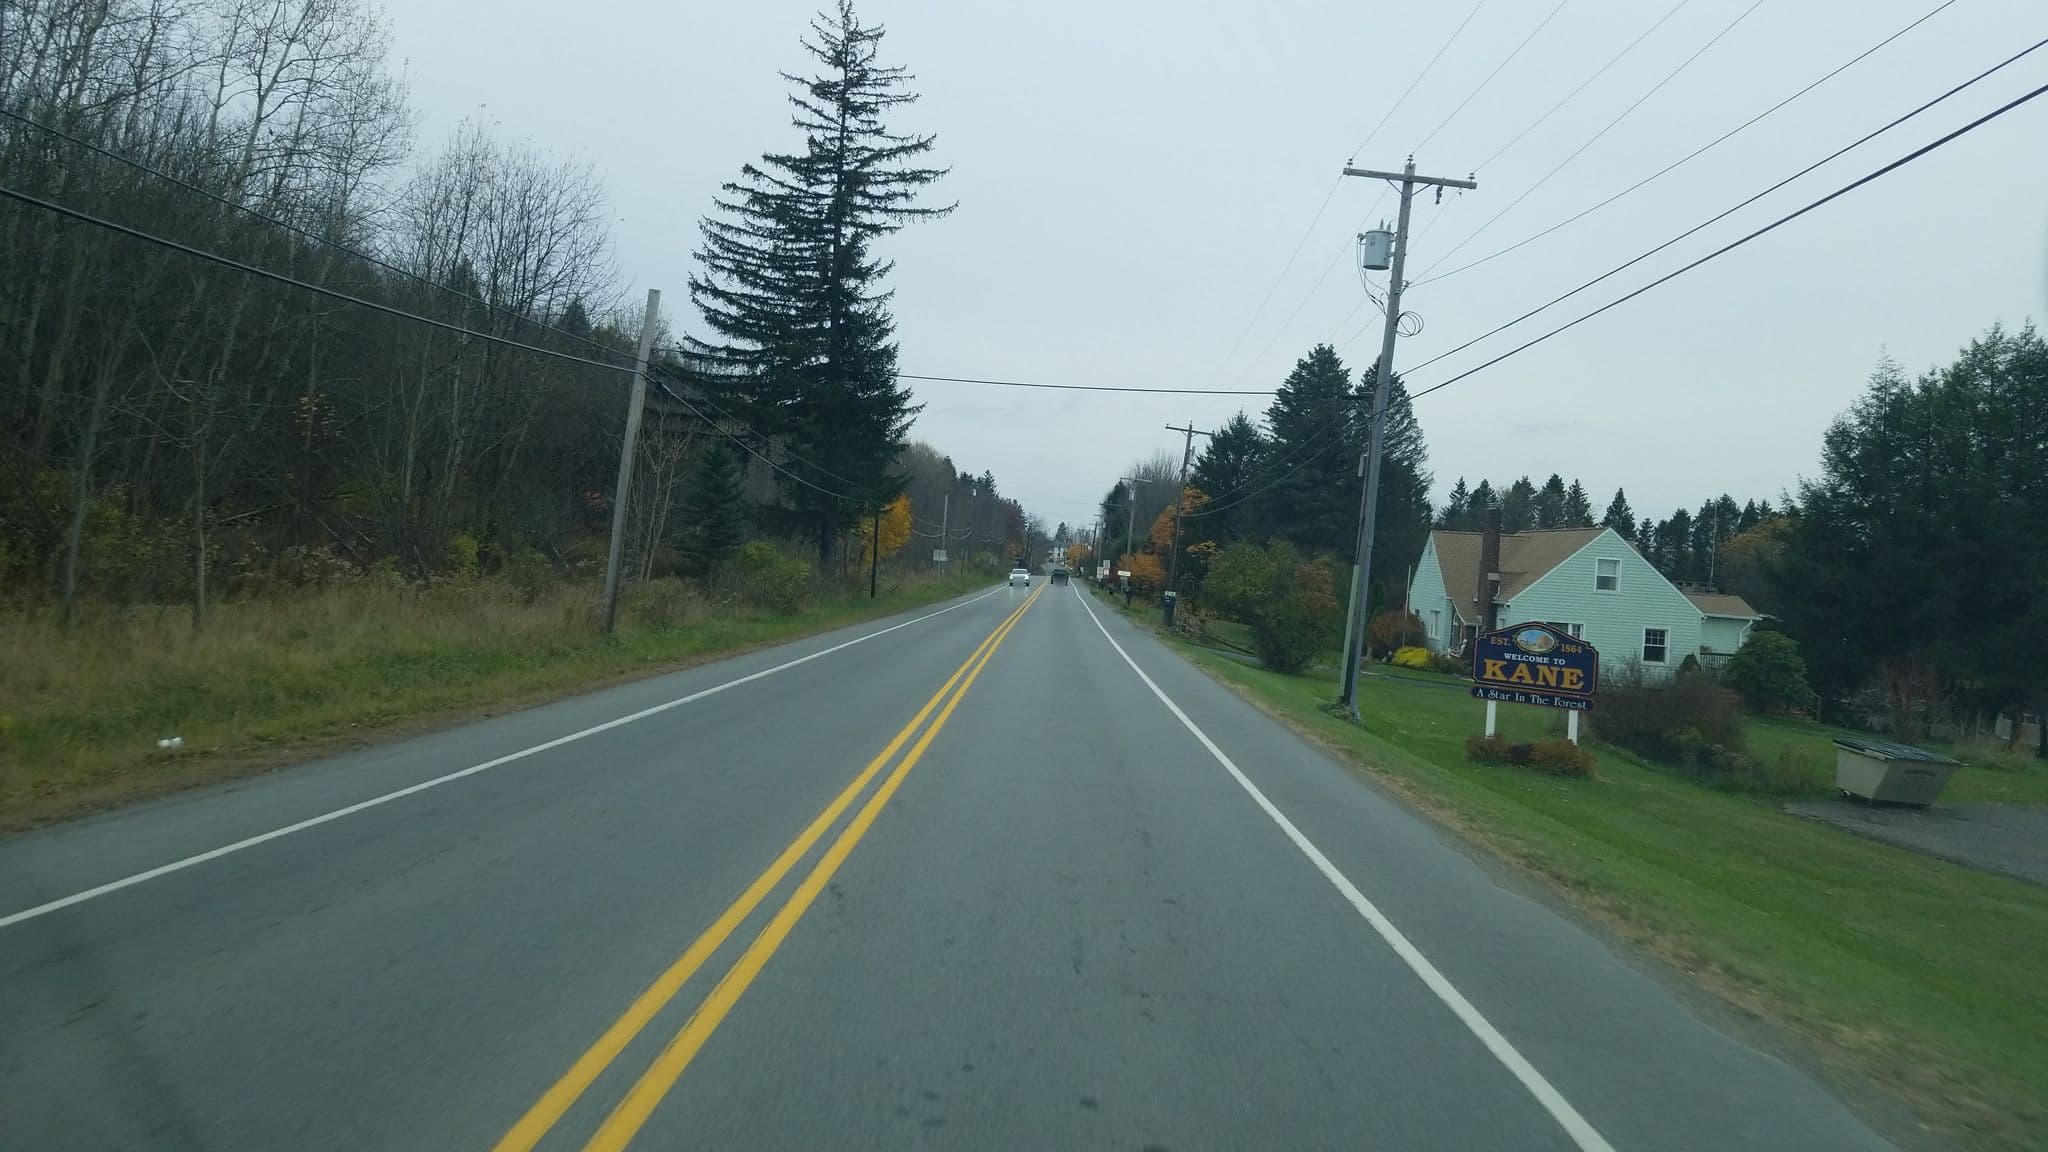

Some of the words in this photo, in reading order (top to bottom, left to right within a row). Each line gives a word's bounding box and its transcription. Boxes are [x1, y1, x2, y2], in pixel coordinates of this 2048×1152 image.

[1561, 644, 1582, 654] 1864
[1504, 653, 1549, 664] WELCOME
[1484, 659, 1584, 689] KANE
[1477, 689, 1484, 697] A
[1488, 690, 1510, 700] Star
[1515, 692, 1525, 701] In
[1530, 694, 1549, 705] The
[1554, 697, 1587, 709] Forest
